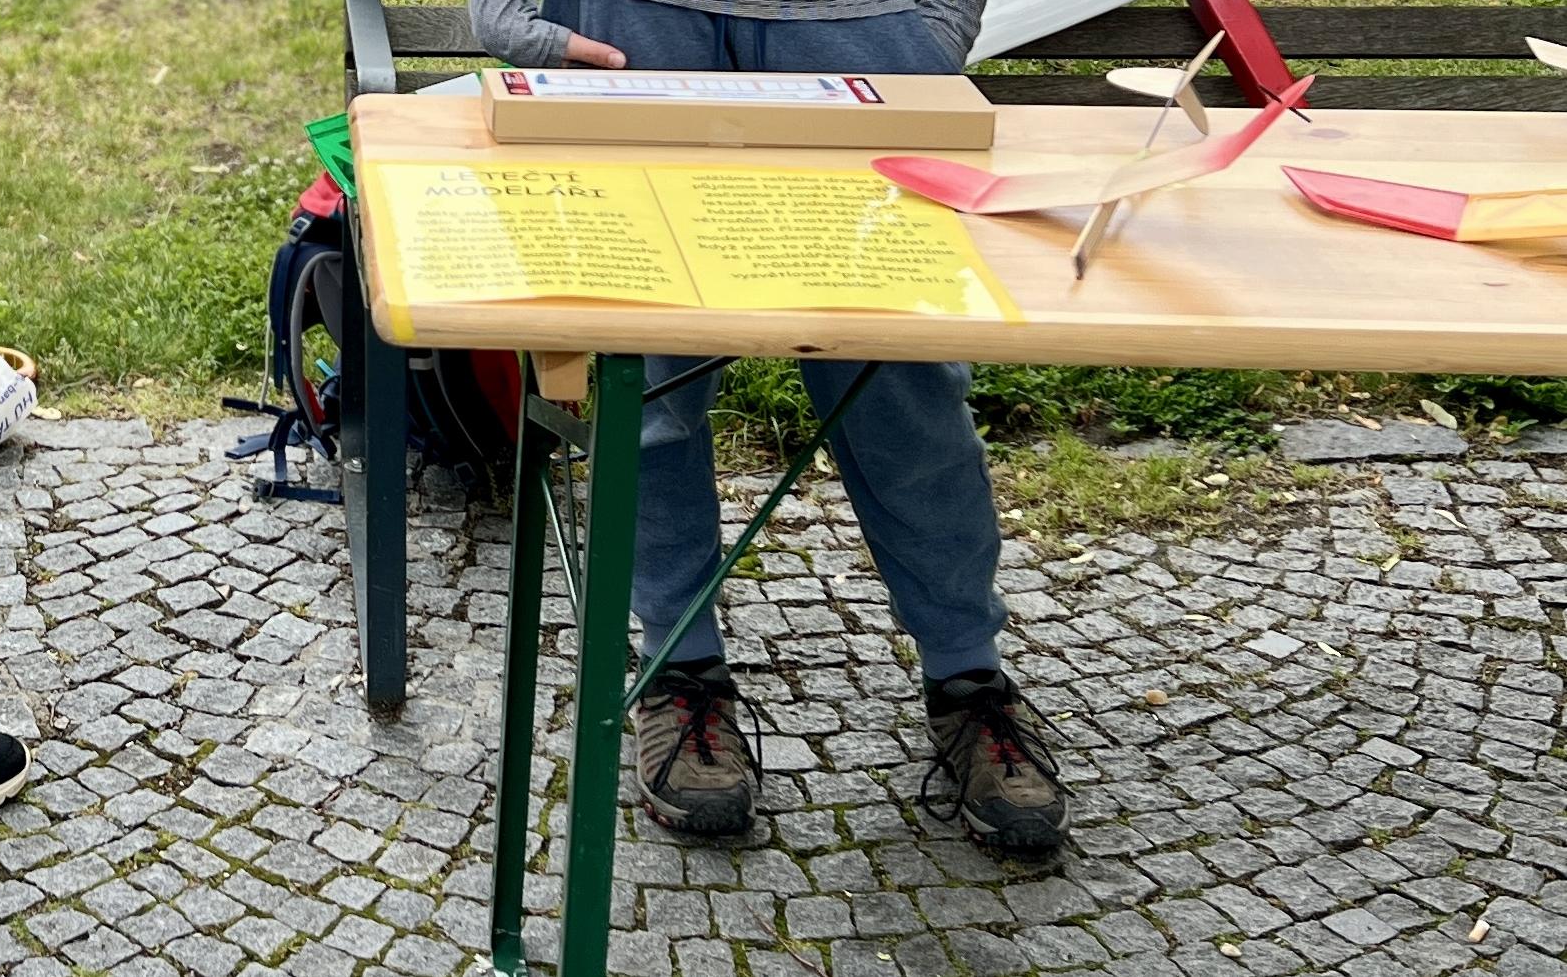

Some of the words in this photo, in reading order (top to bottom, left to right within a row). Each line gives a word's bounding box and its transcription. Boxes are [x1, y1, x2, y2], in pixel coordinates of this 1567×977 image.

[439, 169, 584, 183] LETEČTÍ
[425, 184, 608, 199] MODELÁŘI
[534, 234, 649, 245] polytechnická
[580, 271, 673, 284] papírových
